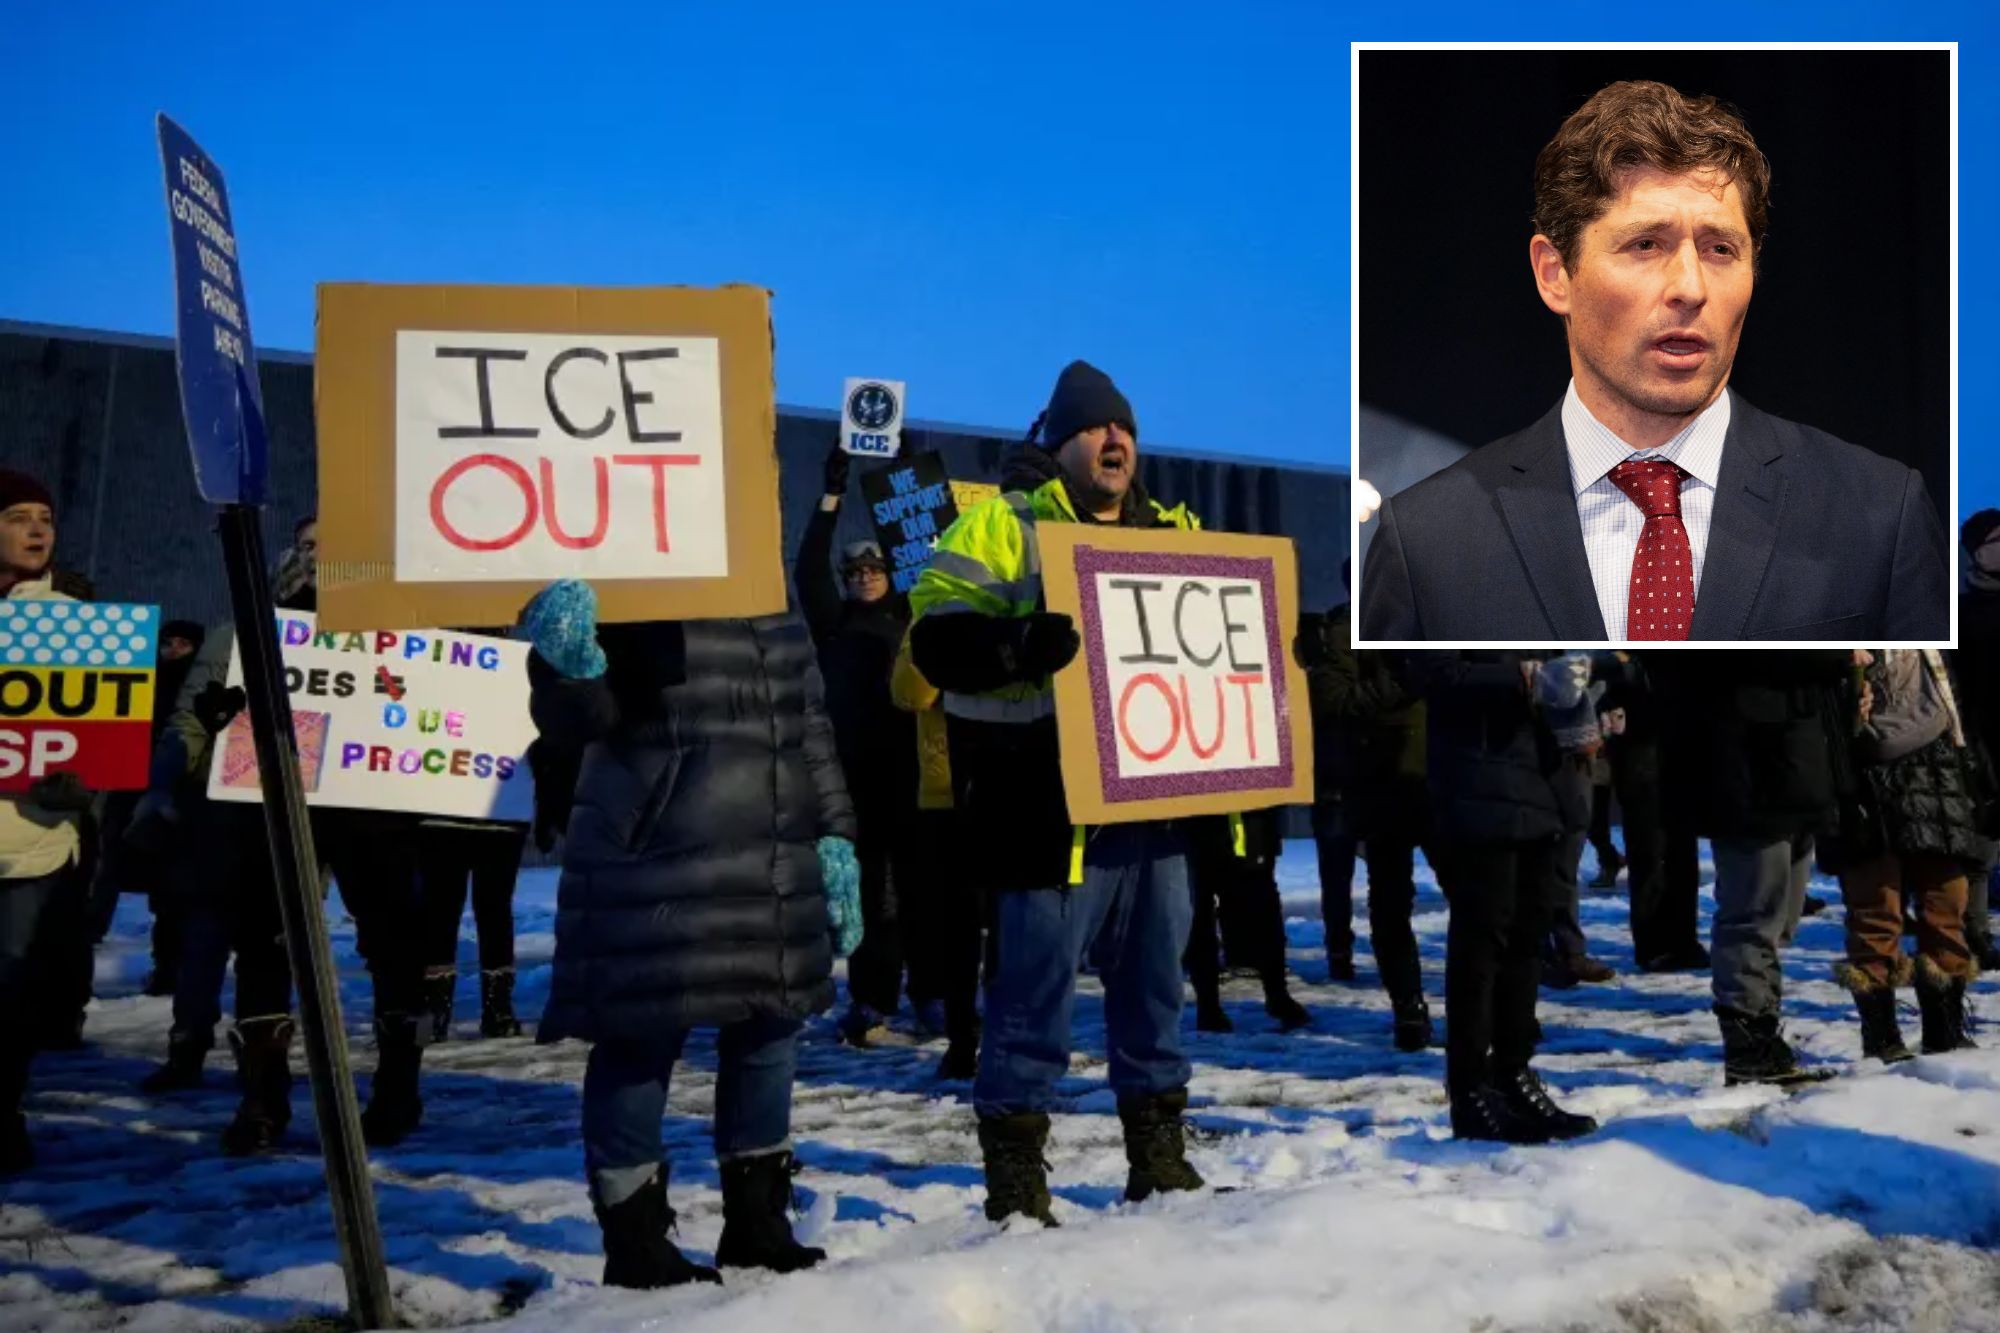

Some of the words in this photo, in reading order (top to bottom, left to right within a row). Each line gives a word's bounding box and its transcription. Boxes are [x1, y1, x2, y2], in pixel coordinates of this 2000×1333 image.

[179, 157, 225, 221] FEDERAL
[172, 189, 236, 261] GOVERNMENT
[435, 346, 682, 443] ICE
[850, 432, 889, 452] ICE
[429, 453, 700, 553] OUT
[873, 483, 947, 526] SUPPORT
[888, 467, 919, 495] WE
[901, 511, 936, 541] OUR
[275, 618, 499, 671] DNAPPING
[1109, 578, 1263, 672] ICE
[0, 670, 149, 717] OUT
[284, 666, 356, 698] OES
[383, 703, 465, 738] DUE
[1118, 672, 1264, 762] OUT
[341, 742, 517, 780] PROCESS
